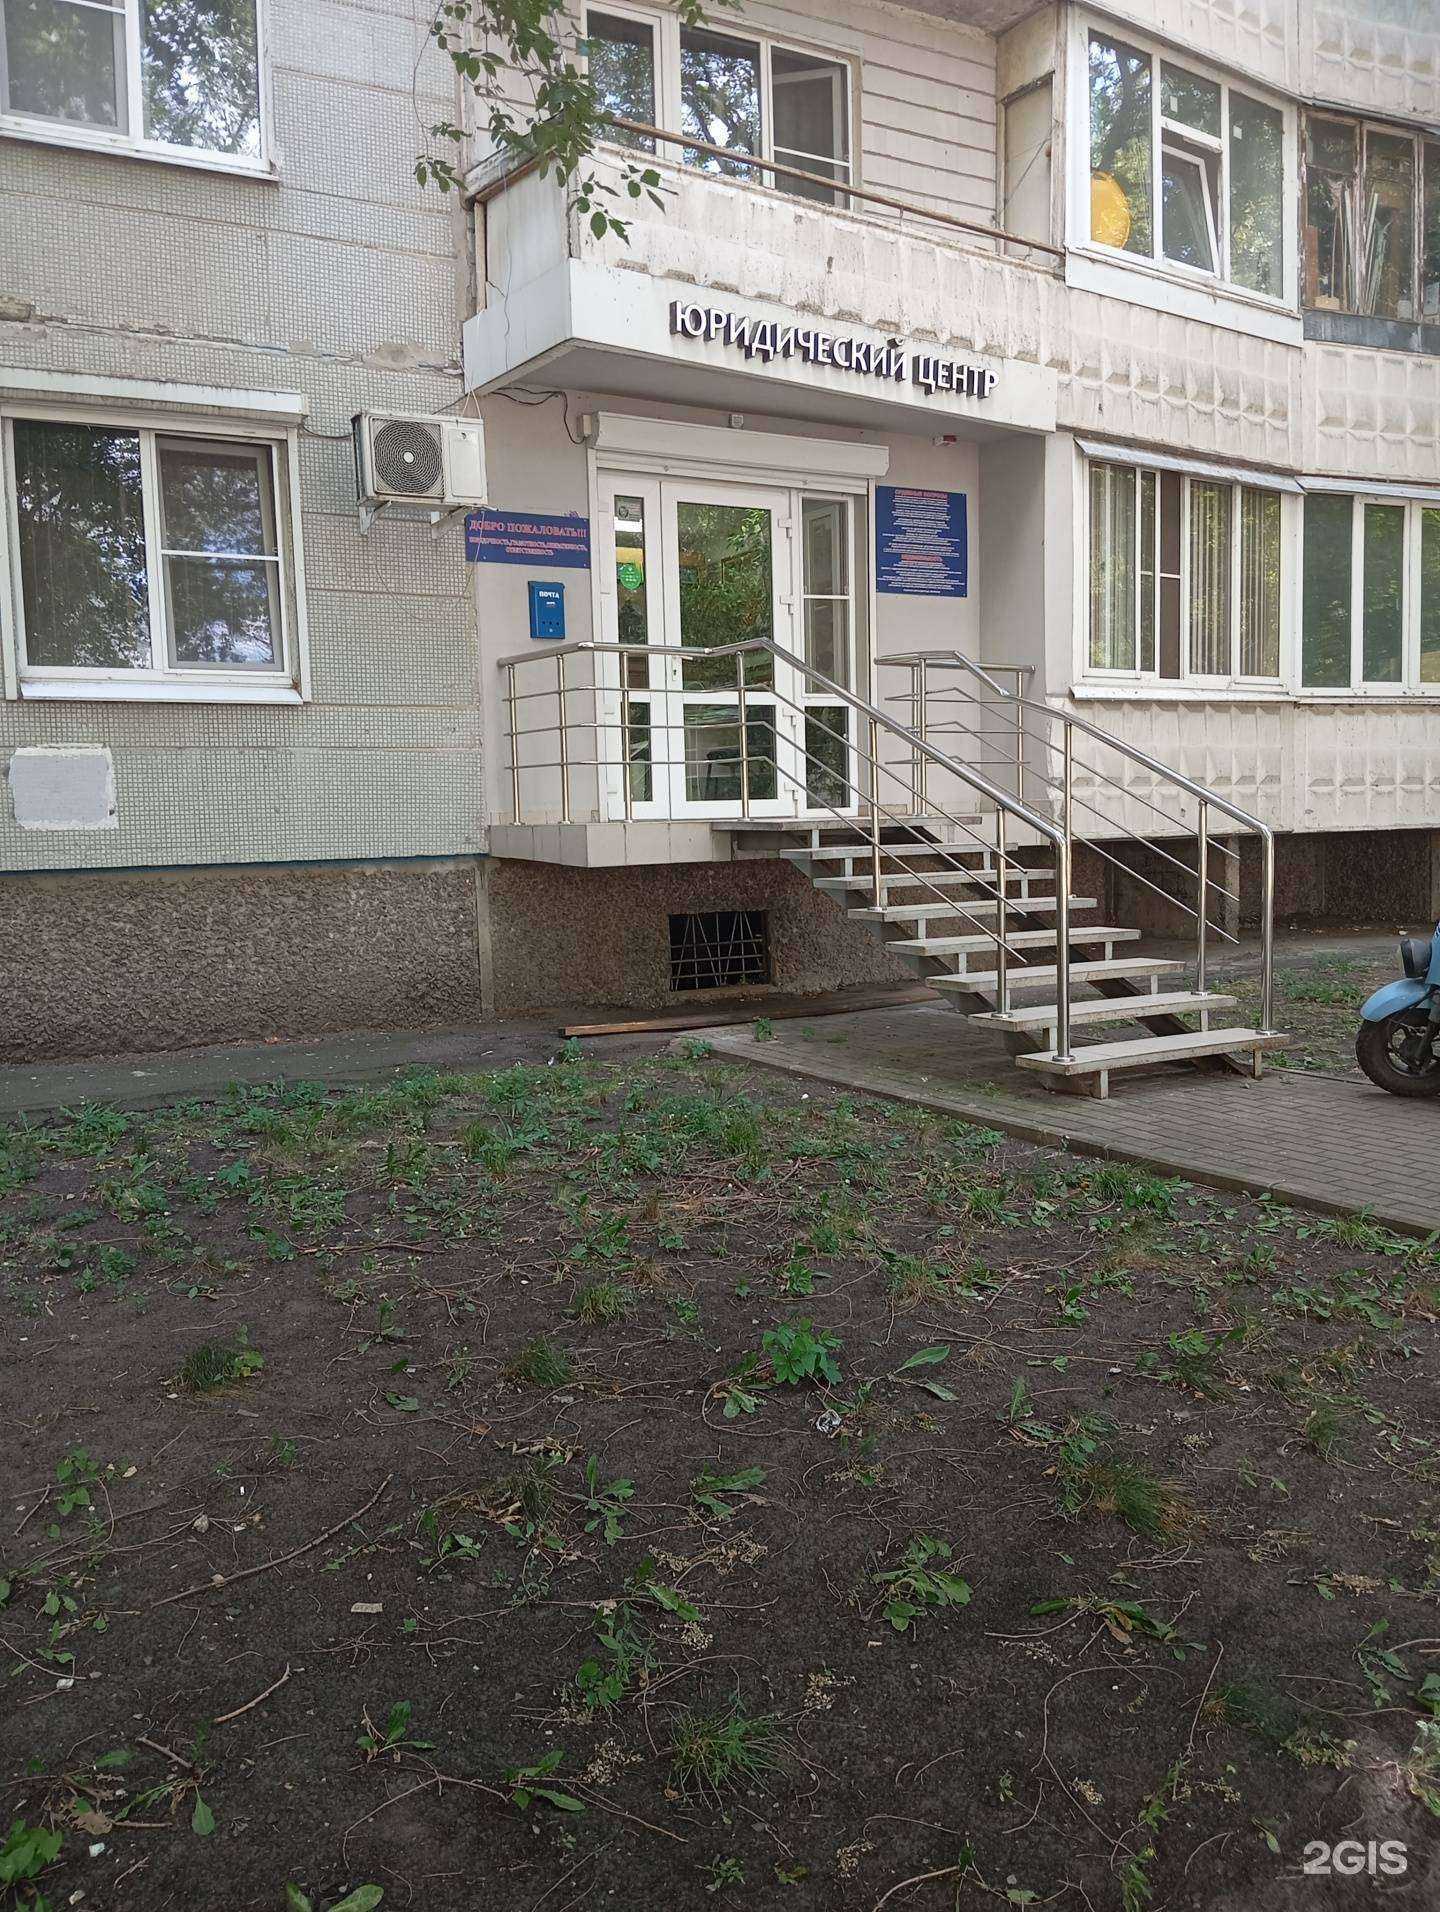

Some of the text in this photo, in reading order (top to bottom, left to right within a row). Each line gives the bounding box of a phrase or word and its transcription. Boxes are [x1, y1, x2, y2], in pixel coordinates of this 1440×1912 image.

[670, 300, 1001, 398] ЮРИДИЧЕСКИЙ ЦЕНТР
[469, 519, 505, 532] ДОБРО
[538, 590, 560, 599] ПОЧТА
